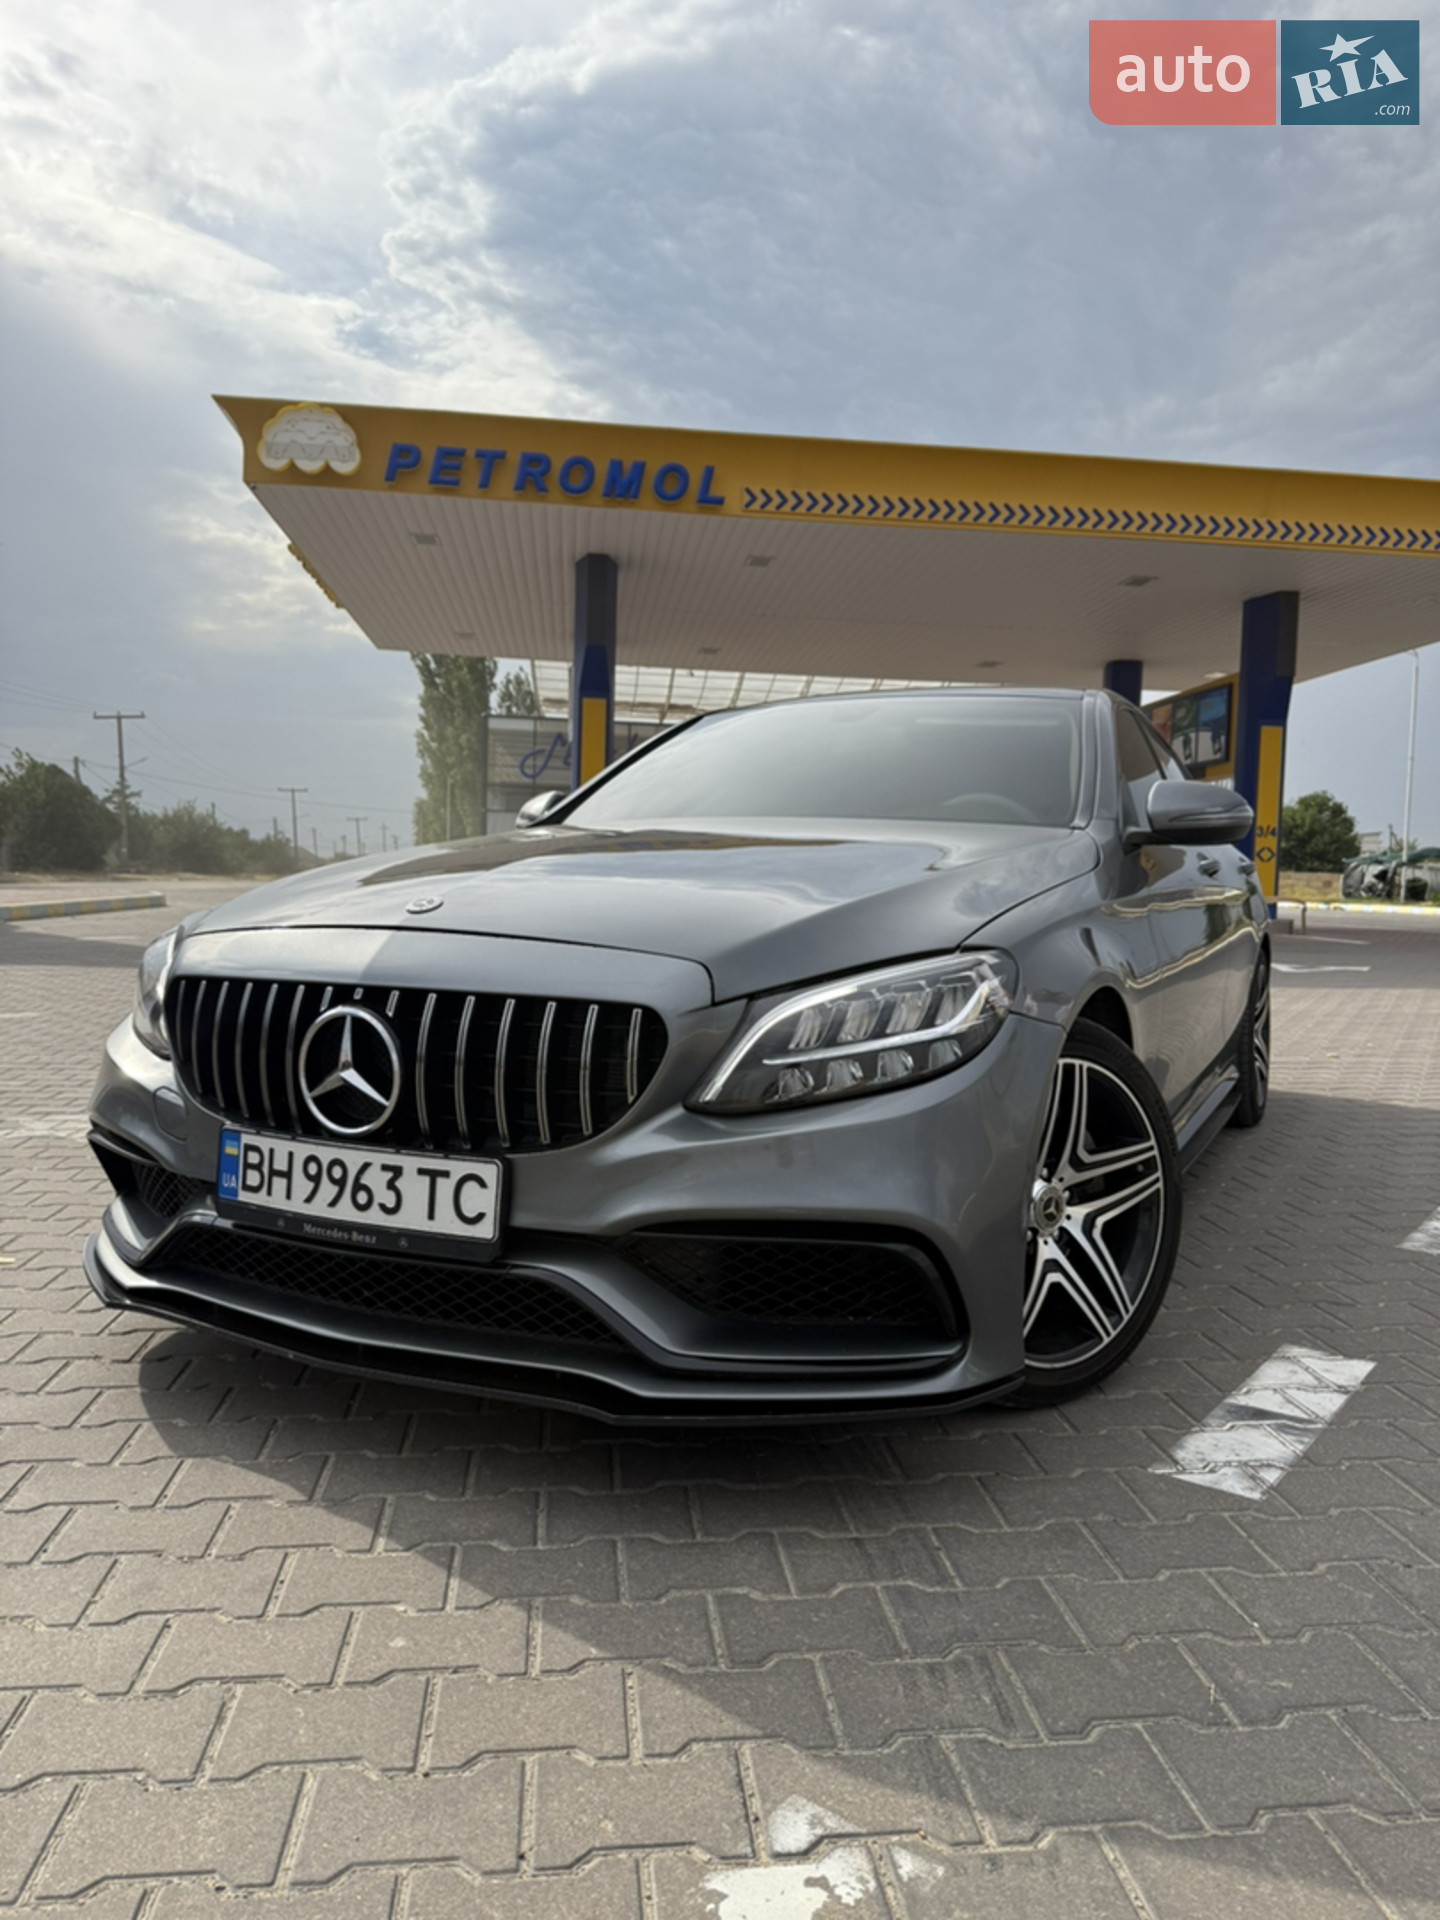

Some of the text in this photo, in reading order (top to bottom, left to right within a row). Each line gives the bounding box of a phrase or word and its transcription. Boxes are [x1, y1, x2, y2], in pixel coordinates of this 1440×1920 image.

[383, 442, 726, 507] PETROMOL
[1256, 824, 1277, 839] 3/4
[222, 1173, 237, 1189] UA
[241, 1143, 488, 1225] BH 9963 TC
[303, 1222, 377, 1245] Mercedes-Benz
